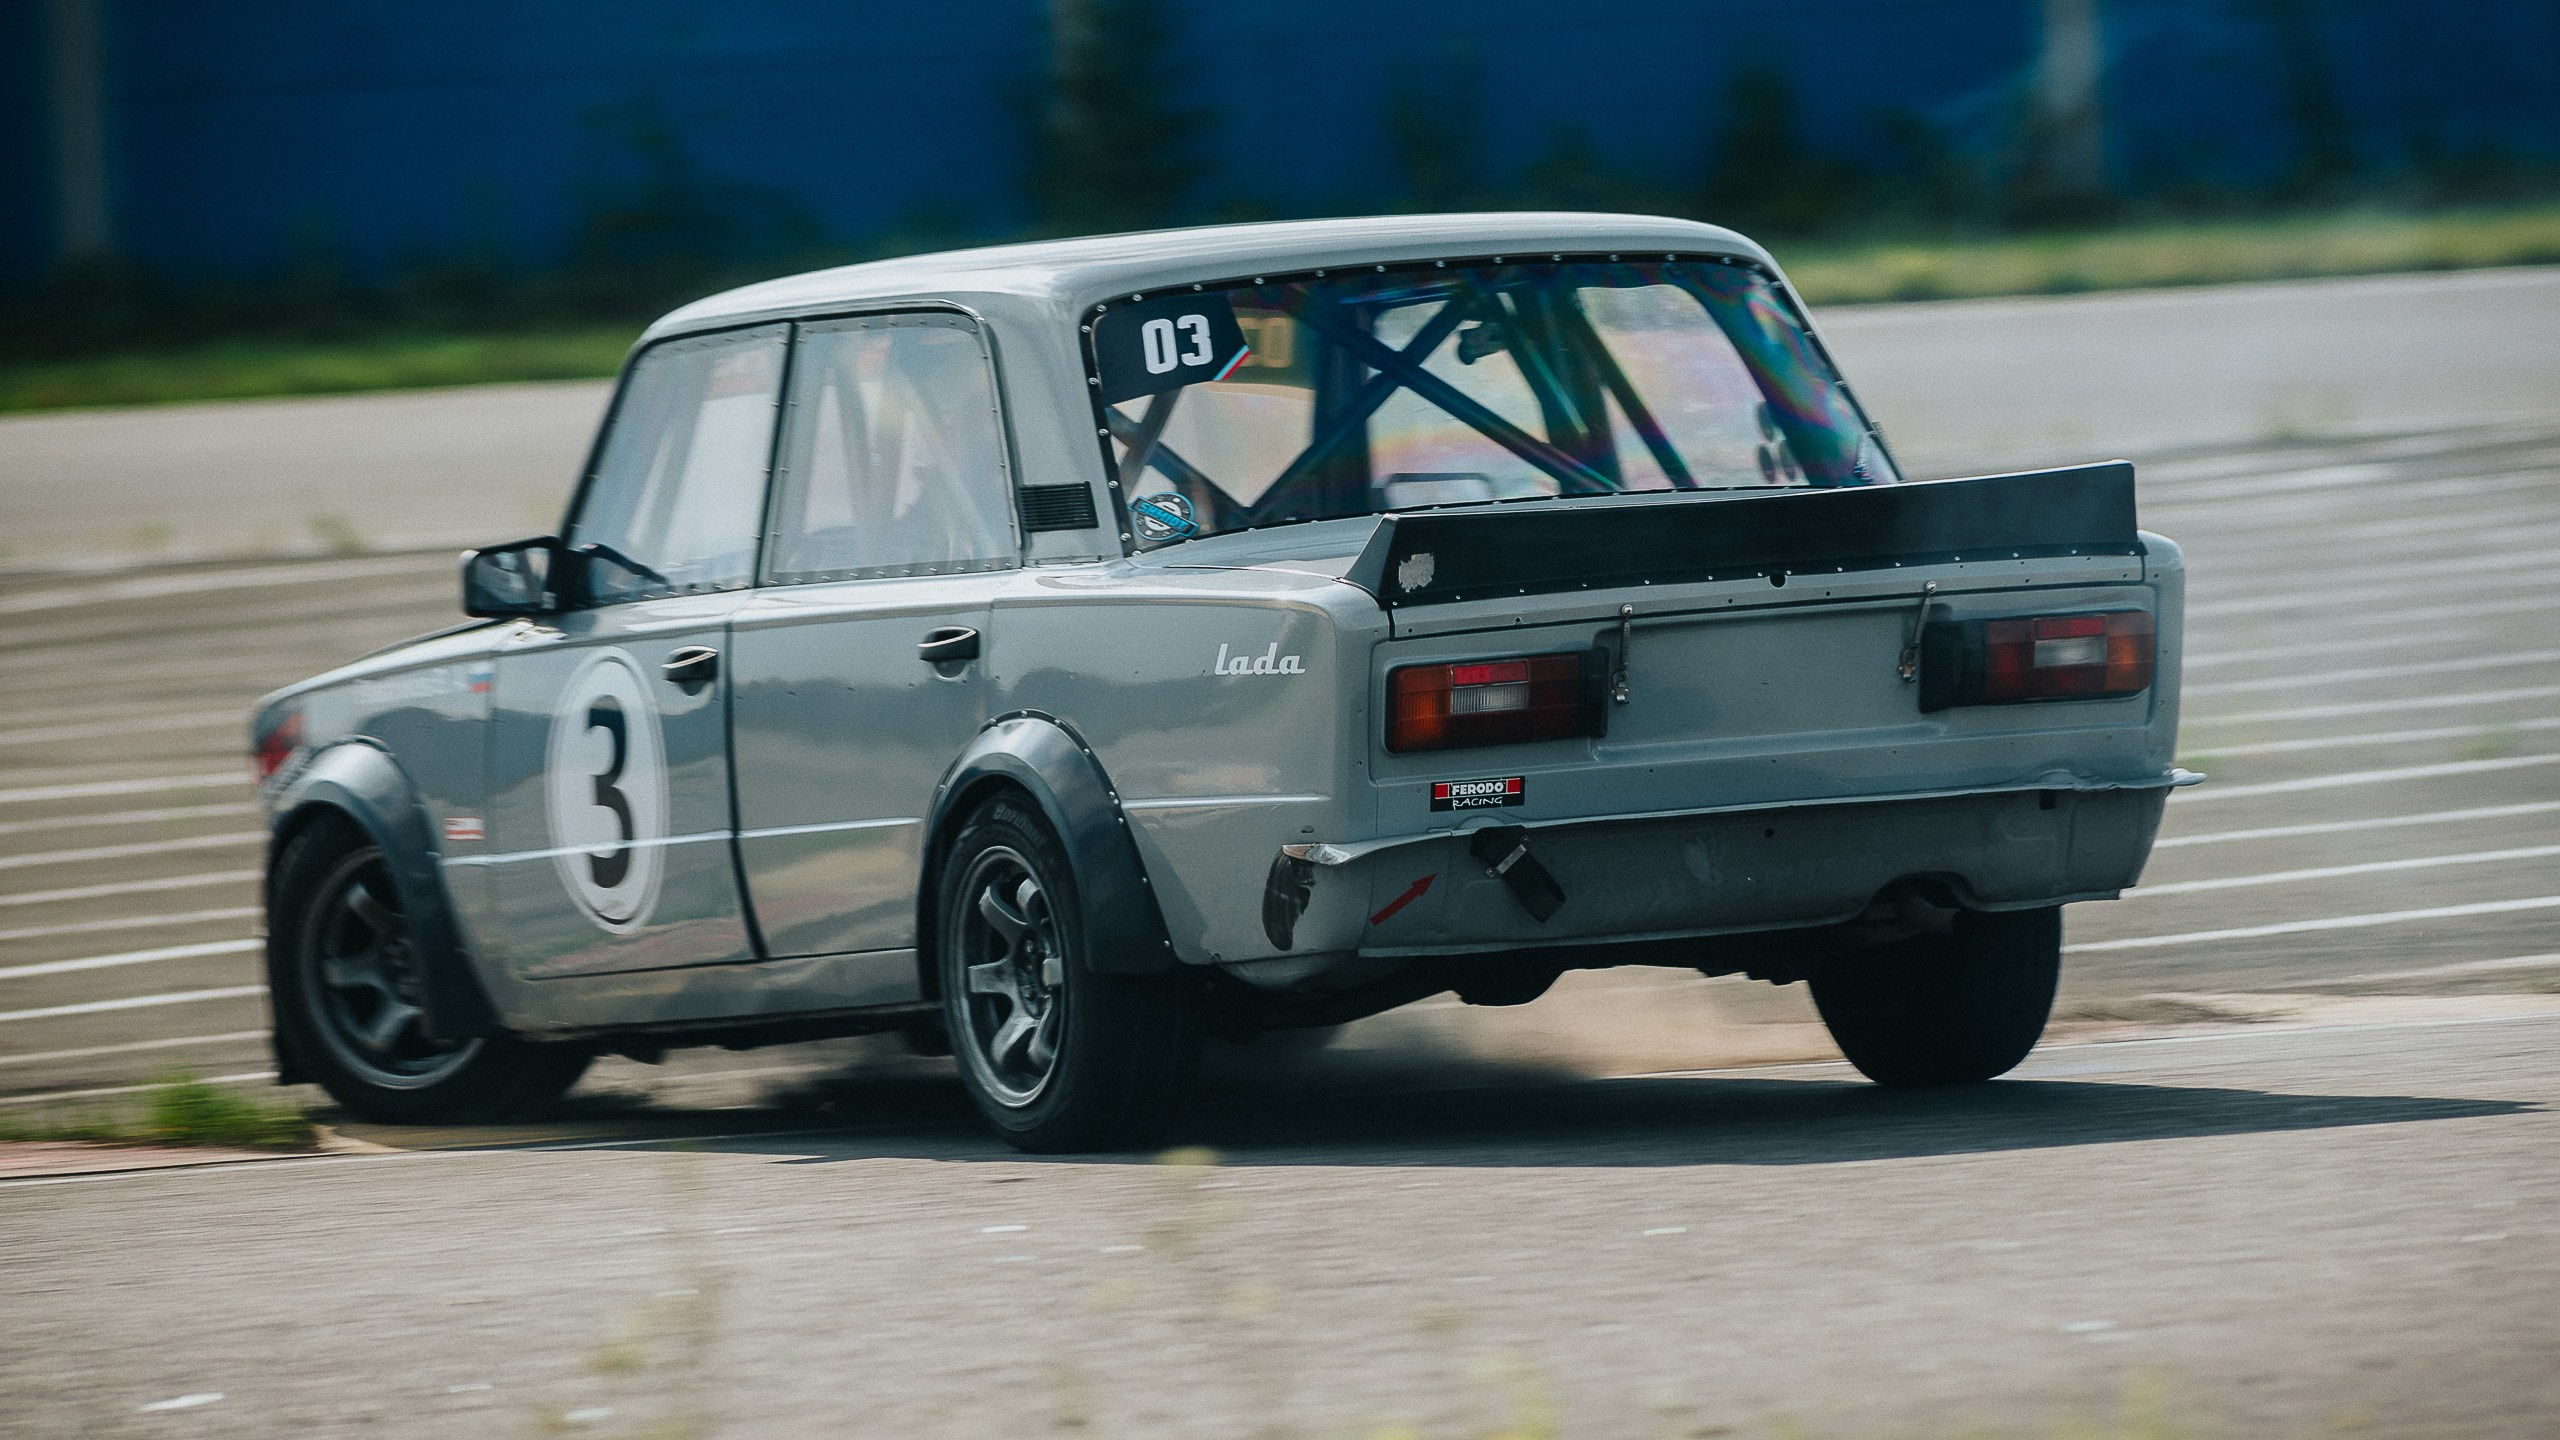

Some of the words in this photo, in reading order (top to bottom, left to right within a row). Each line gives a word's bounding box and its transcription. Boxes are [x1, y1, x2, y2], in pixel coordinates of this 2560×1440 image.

[1141, 314, 1213, 374] 03
[1214, 642, 1306, 676] lada
[584, 694, 634, 889] 3
[1452, 782, 1504, 796] FERODO
[1452, 797, 1503, 811] RACING
